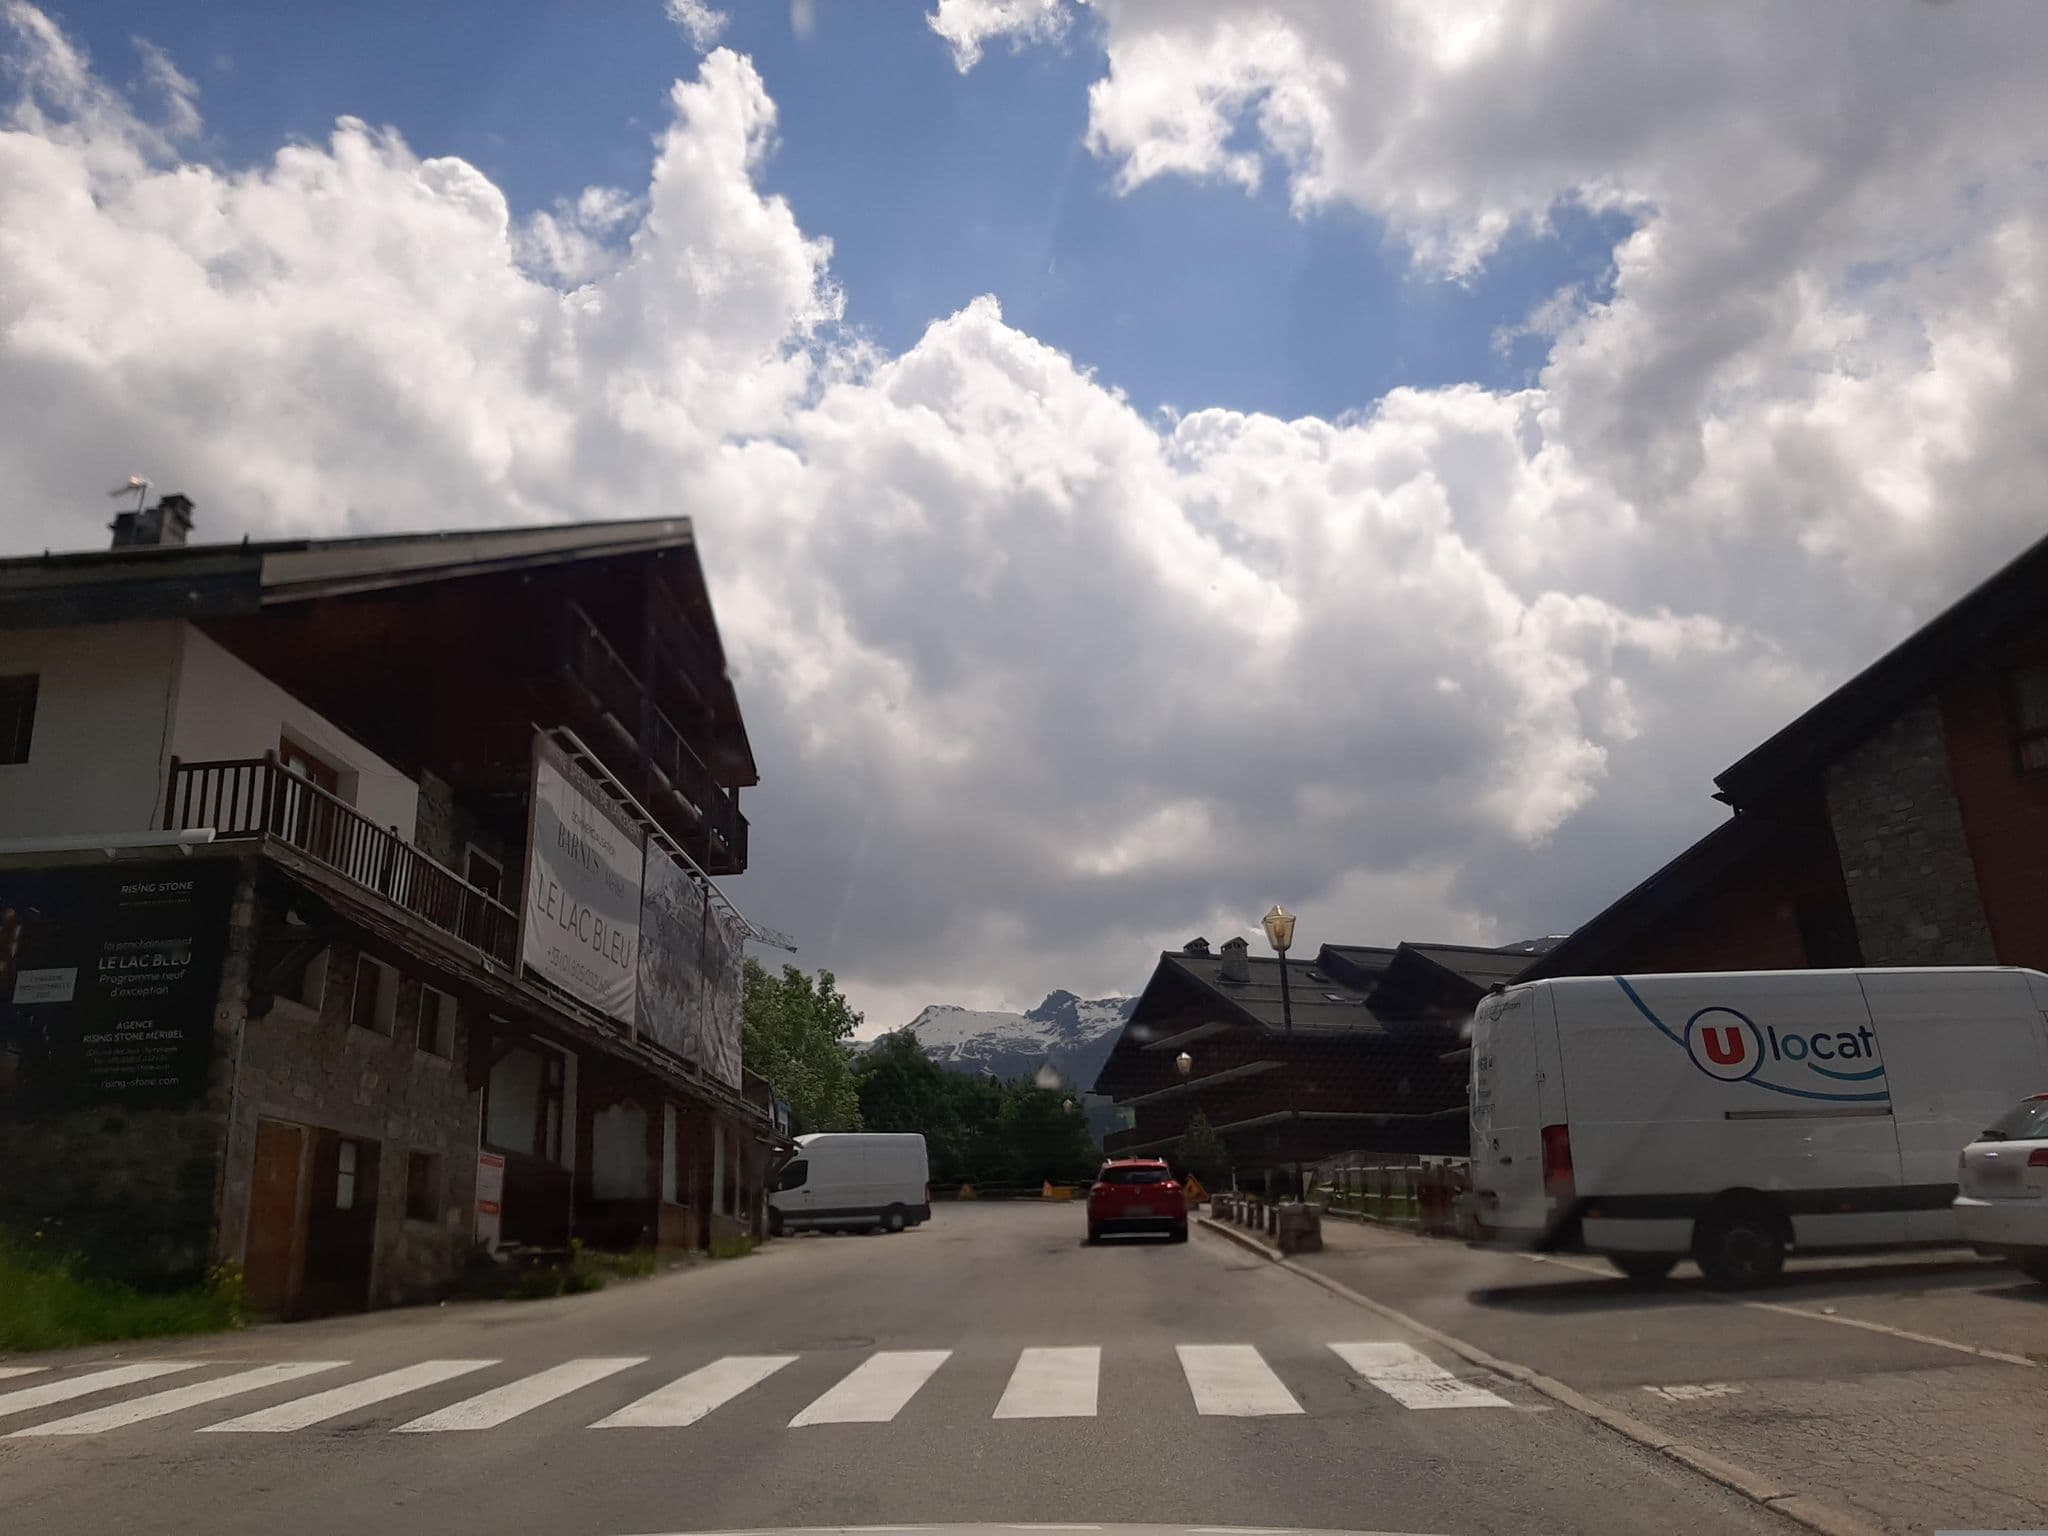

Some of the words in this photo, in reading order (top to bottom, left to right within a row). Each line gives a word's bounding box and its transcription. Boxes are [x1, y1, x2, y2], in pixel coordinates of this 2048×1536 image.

[121, 883, 156, 894] RISING
[158, 881, 194, 892] STONE
[537, 873, 557, 920] LE
[559, 891, 591, 943] LAC
[592, 917, 631, 969] BLEU
[98, 956, 117, 970] LE
[119, 954, 148, 969] LAC
[99, 973, 160, 986] Programme
[116, 1020, 153, 1030] AGENCE
[83, 1032, 113, 1043] RISING
[114, 1032, 145, 1042] STONE
[1702, 1027, 1746, 1065] U
[1767, 1025, 1873, 1061] locat
